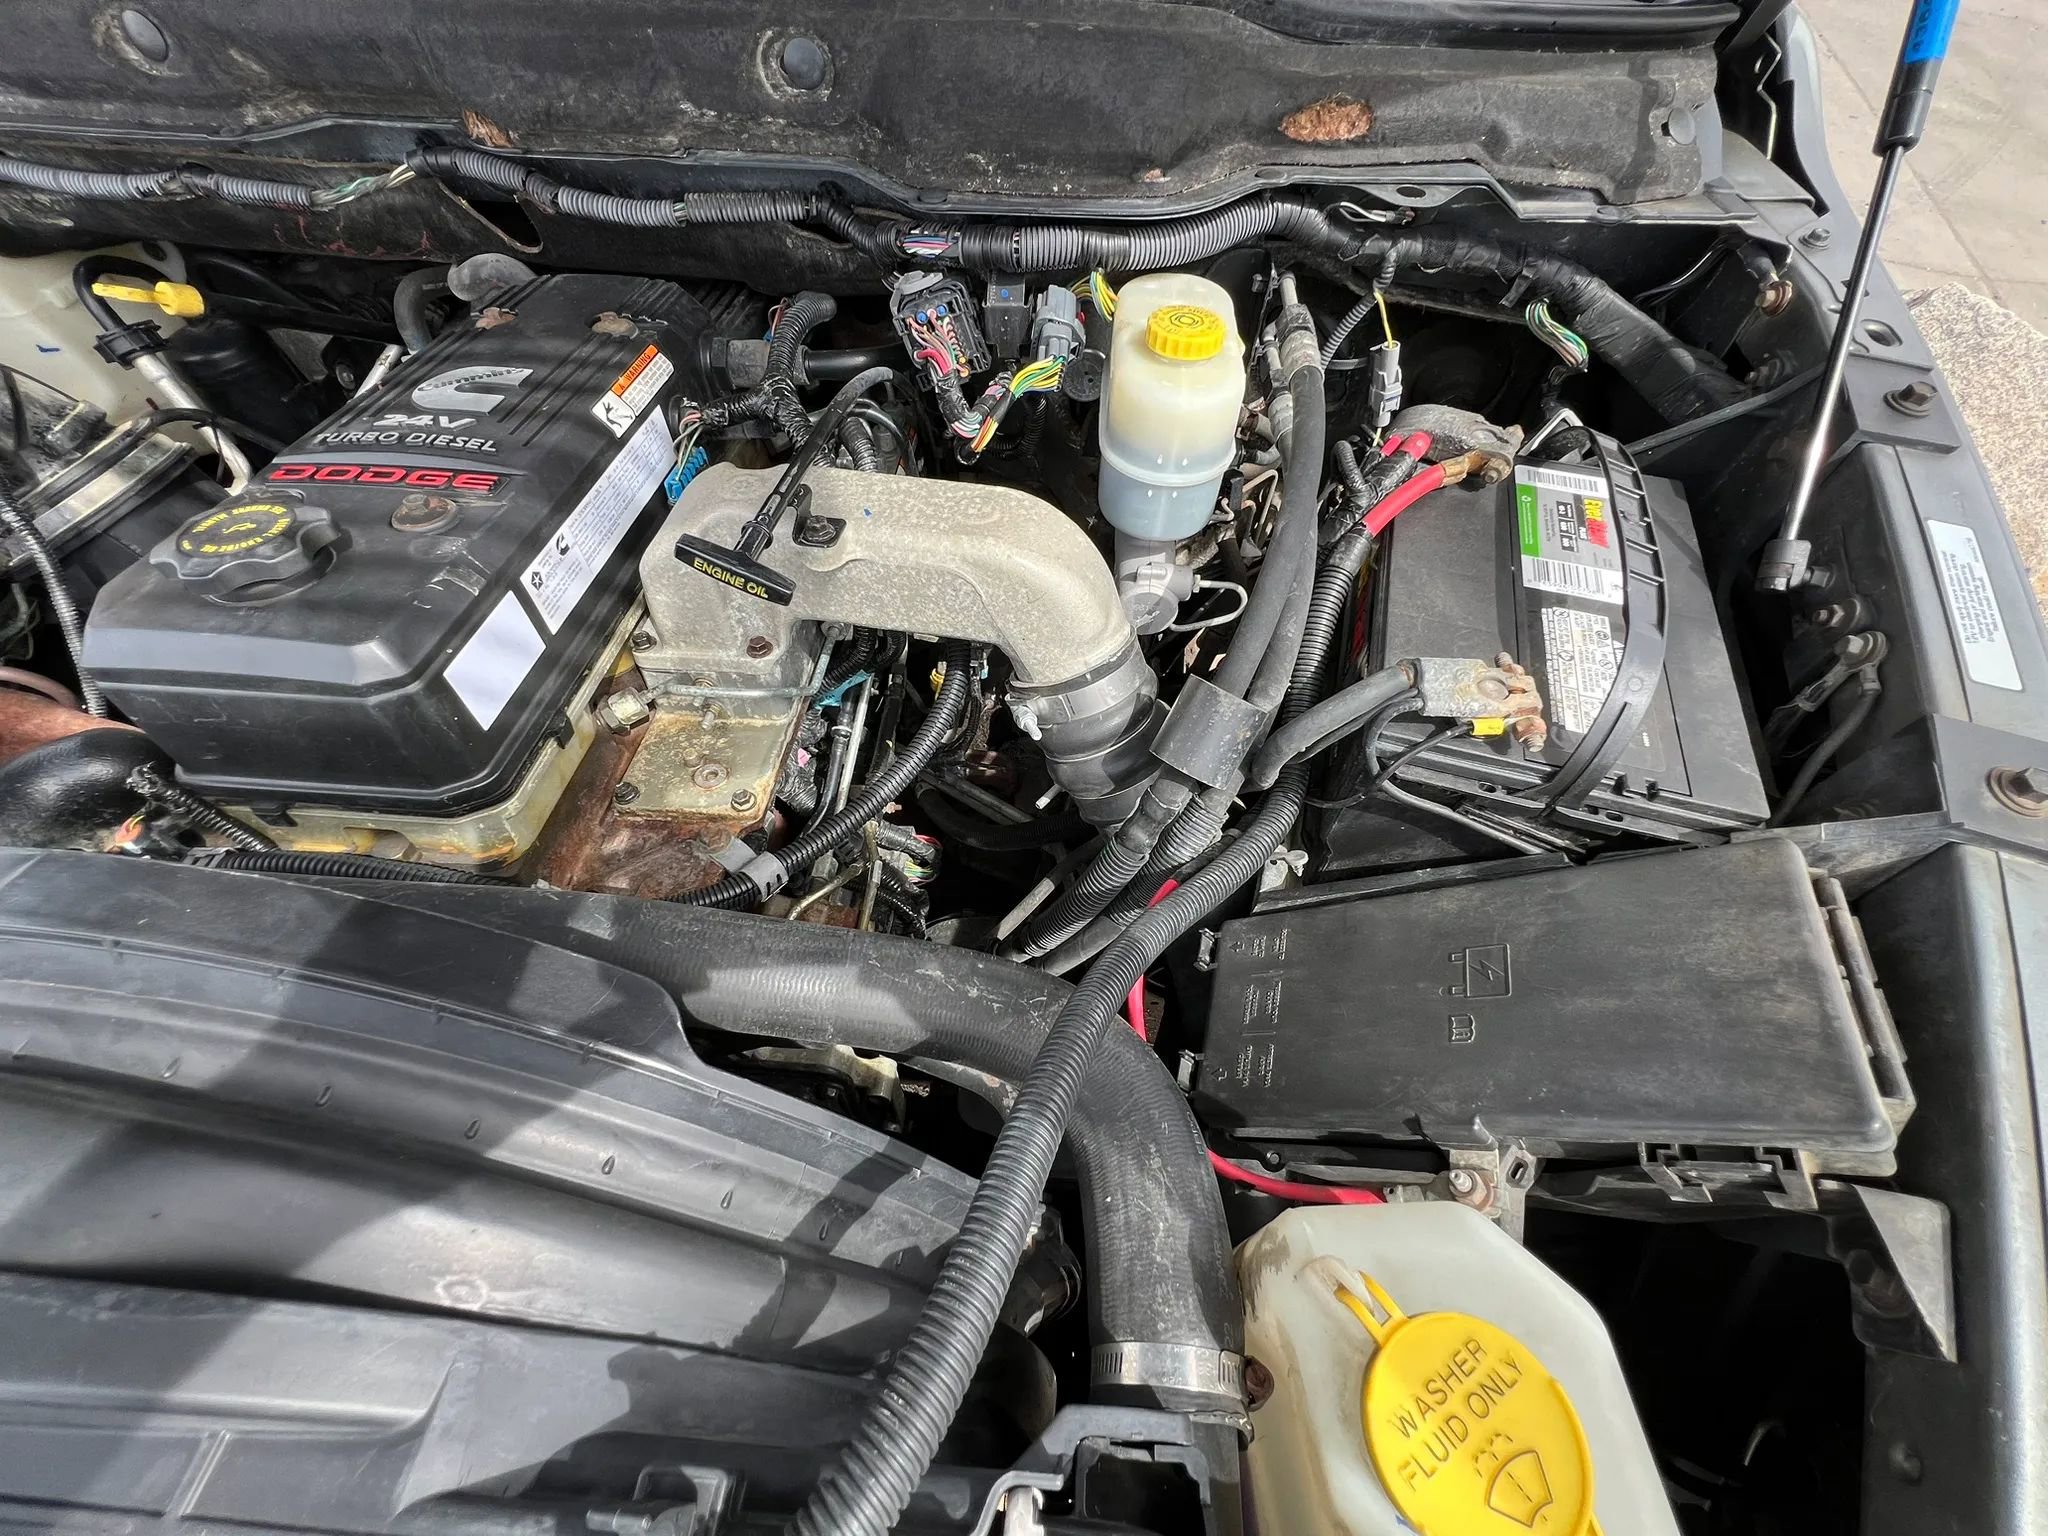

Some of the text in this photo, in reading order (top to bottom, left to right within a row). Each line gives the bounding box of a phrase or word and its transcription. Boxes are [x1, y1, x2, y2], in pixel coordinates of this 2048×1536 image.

[624, 352, 651, 382] WARNING
[372, 413, 478, 431] 24V
[314, 431, 497, 453] TURBO DIESEL
[268, 464, 500, 493] DODGE
[693, 557, 769, 599] ENGINE OIL
[1388, 1338, 1488, 1439] WASHER
[1399, 1353, 1523, 1494] FLUID ONLY
